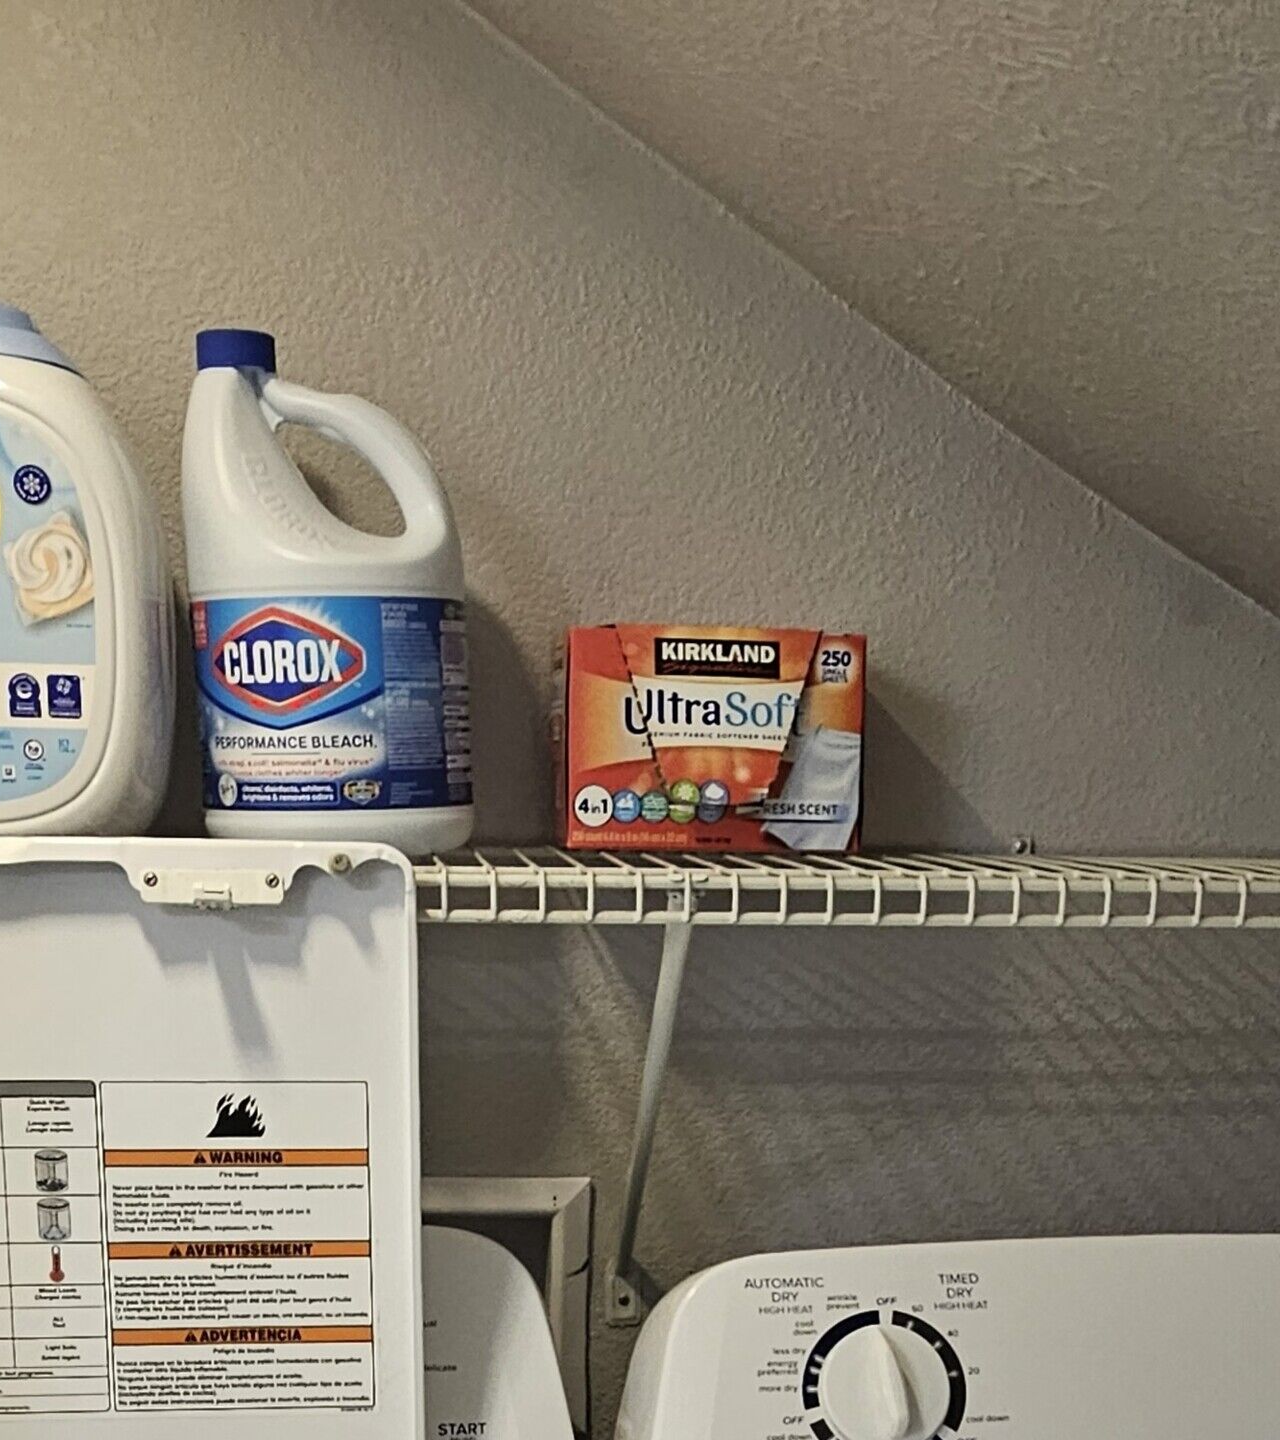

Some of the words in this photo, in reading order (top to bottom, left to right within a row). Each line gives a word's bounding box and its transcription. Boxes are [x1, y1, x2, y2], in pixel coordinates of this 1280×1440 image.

[662, 641, 775, 663] KIRKLAND
[822, 651, 851, 666] 250
[223, 639, 343, 685] CLOROX
[215, 736, 307, 750] PERFORMANCE
[578, 798, 589, 814] 4
[591, 804, 601, 814] in
[601, 799, 608, 814] 1
[798, 803, 838, 816] SCENT
[210, 1151, 283, 1164] WARNING
[186, 1243, 314, 1257] AVERTISSEMENT
[744, 1276, 824, 1289] AUTOMATIC
[937, 1272, 979, 1285] TIMED
[771, 1291, 799, 1303] DRY
[946, 1287, 974, 1299] DRY
[826, 1301, 860, 1311] prevent
[876, 1296, 898, 1306] OFF
[933, 1302, 960, 1311] HIGH
[961, 1300, 988, 1310] HEAT
[758, 1305, 785, 1315] HIGH
[787, 1304, 813, 1314] HEAT
[911, 1304, 924, 1313] 60
[200, 1328, 302, 1342] ADVERTENCIA
[967, 1366, 980, 1376] 20
[782, 1415, 805, 1425] OFF
[438, 1422, 487, 1436] START
[787, 1433, 813, 1440] down
